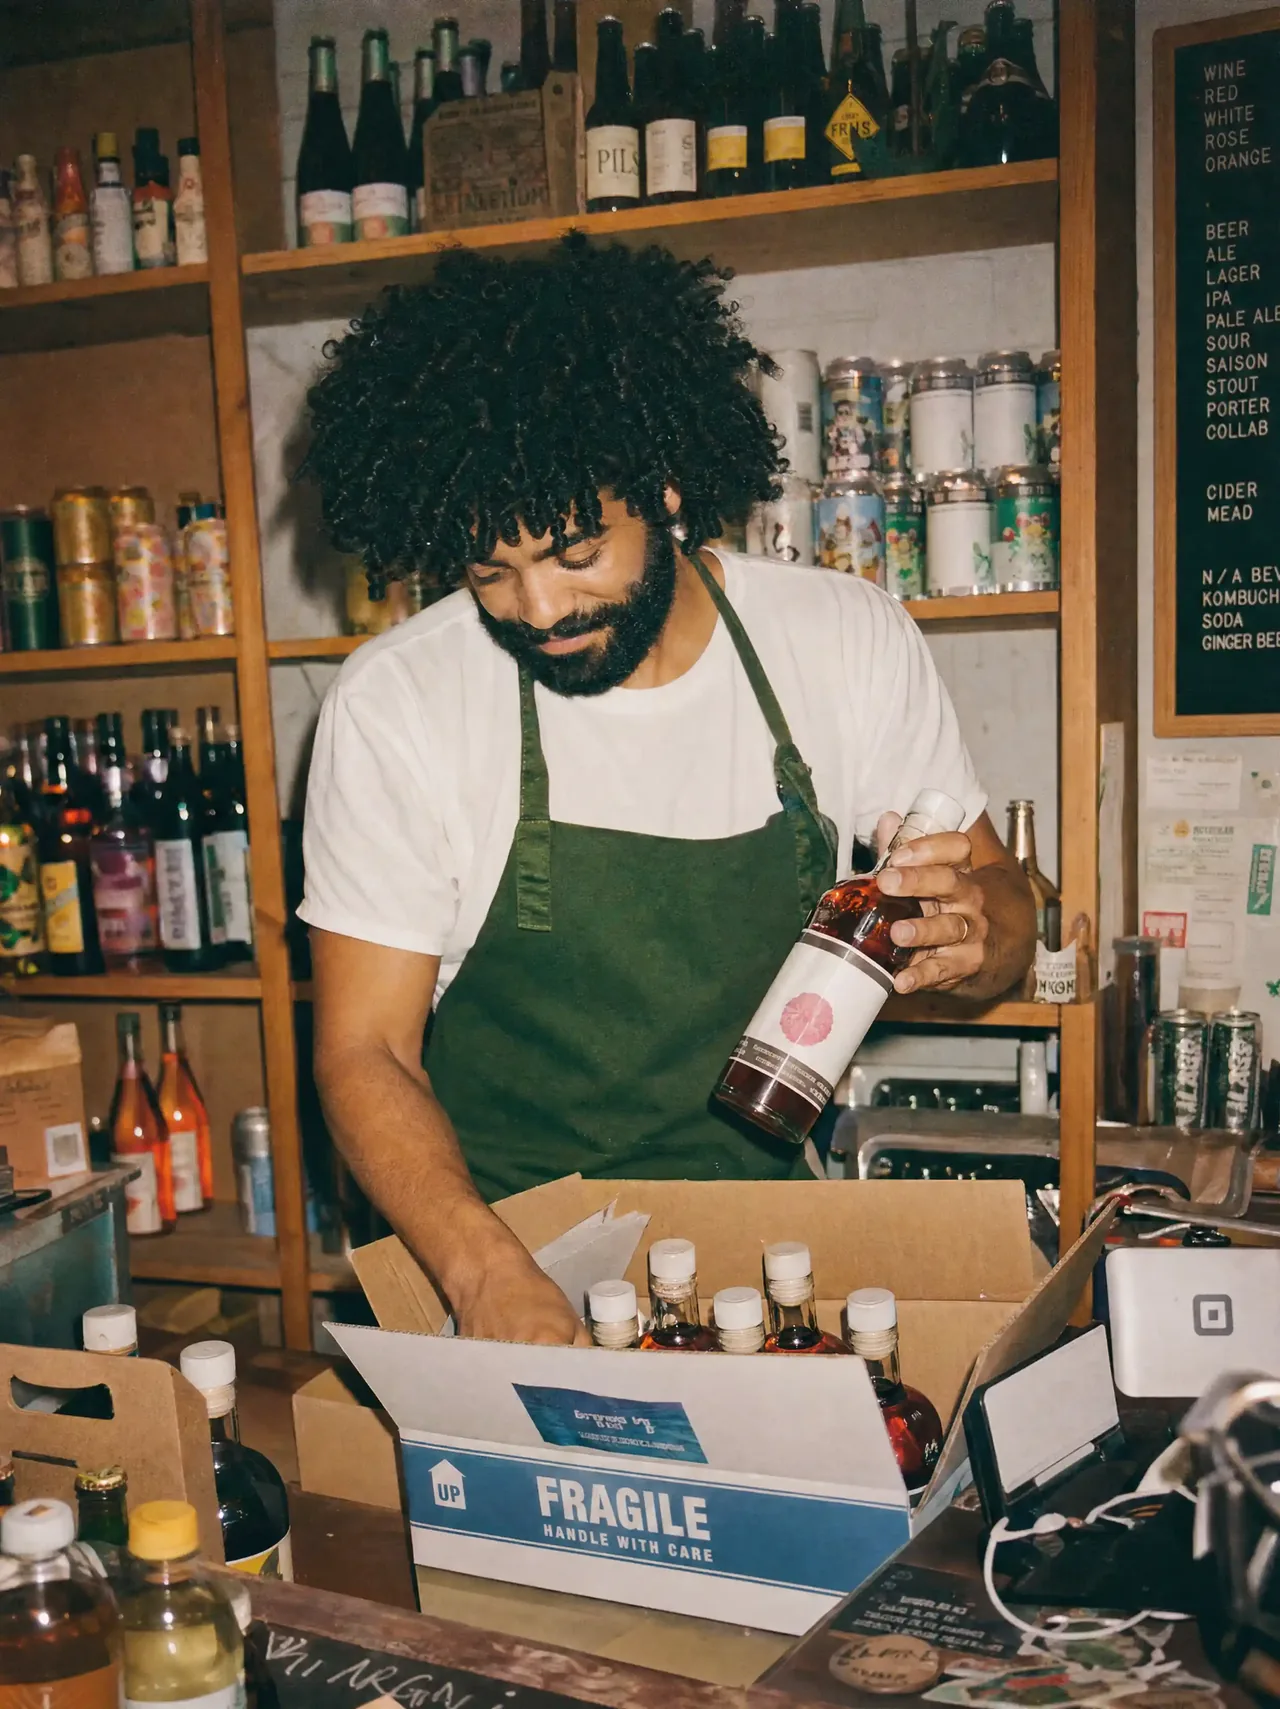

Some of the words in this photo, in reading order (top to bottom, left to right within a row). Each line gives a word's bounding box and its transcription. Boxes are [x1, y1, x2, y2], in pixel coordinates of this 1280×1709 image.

[1204, 60, 1246, 81] WINE
[1205, 85, 1238, 104] RED
[1204, 105, 1254, 127] WHITE
[1205, 128, 1249, 150] ROSE
[1205, 147, 1271, 173] ORANGE
[1206, 220, 1248, 241] BEER
[1205, 244, 1236, 263] ALE
[1206, 264, 1260, 285] LAGER
[1206, 290, 1232, 308] IPA
[1206, 310, 1245, 330] PALE
[1253, 305, 1280, 324] ALE
[1206, 332, 1251, 351] SOUR
[1206, 352, 1268, 373] SAISON
[1206, 376, 1259, 396] STOUT
[1207, 397, 1270, 418] PORTER
[1206, 420, 1268, 440] COLLAB
[1206, 481, 1258, 500] CIDER
[1208, 505, 1253, 522] MEAD
[1202, 588, 1279, 606] KOMBUCH
[1202, 612, 1244, 629] SODA
[1202, 633, 1252, 651] GINGER
[437, 1483, 461, 1503] UP
[536, 1475, 711, 1541] FRAGILE
[543, 1524, 609, 1546] HANDLE
[617, 1535, 660, 1555] WITH
[668, 1543, 714, 1563] CARE
